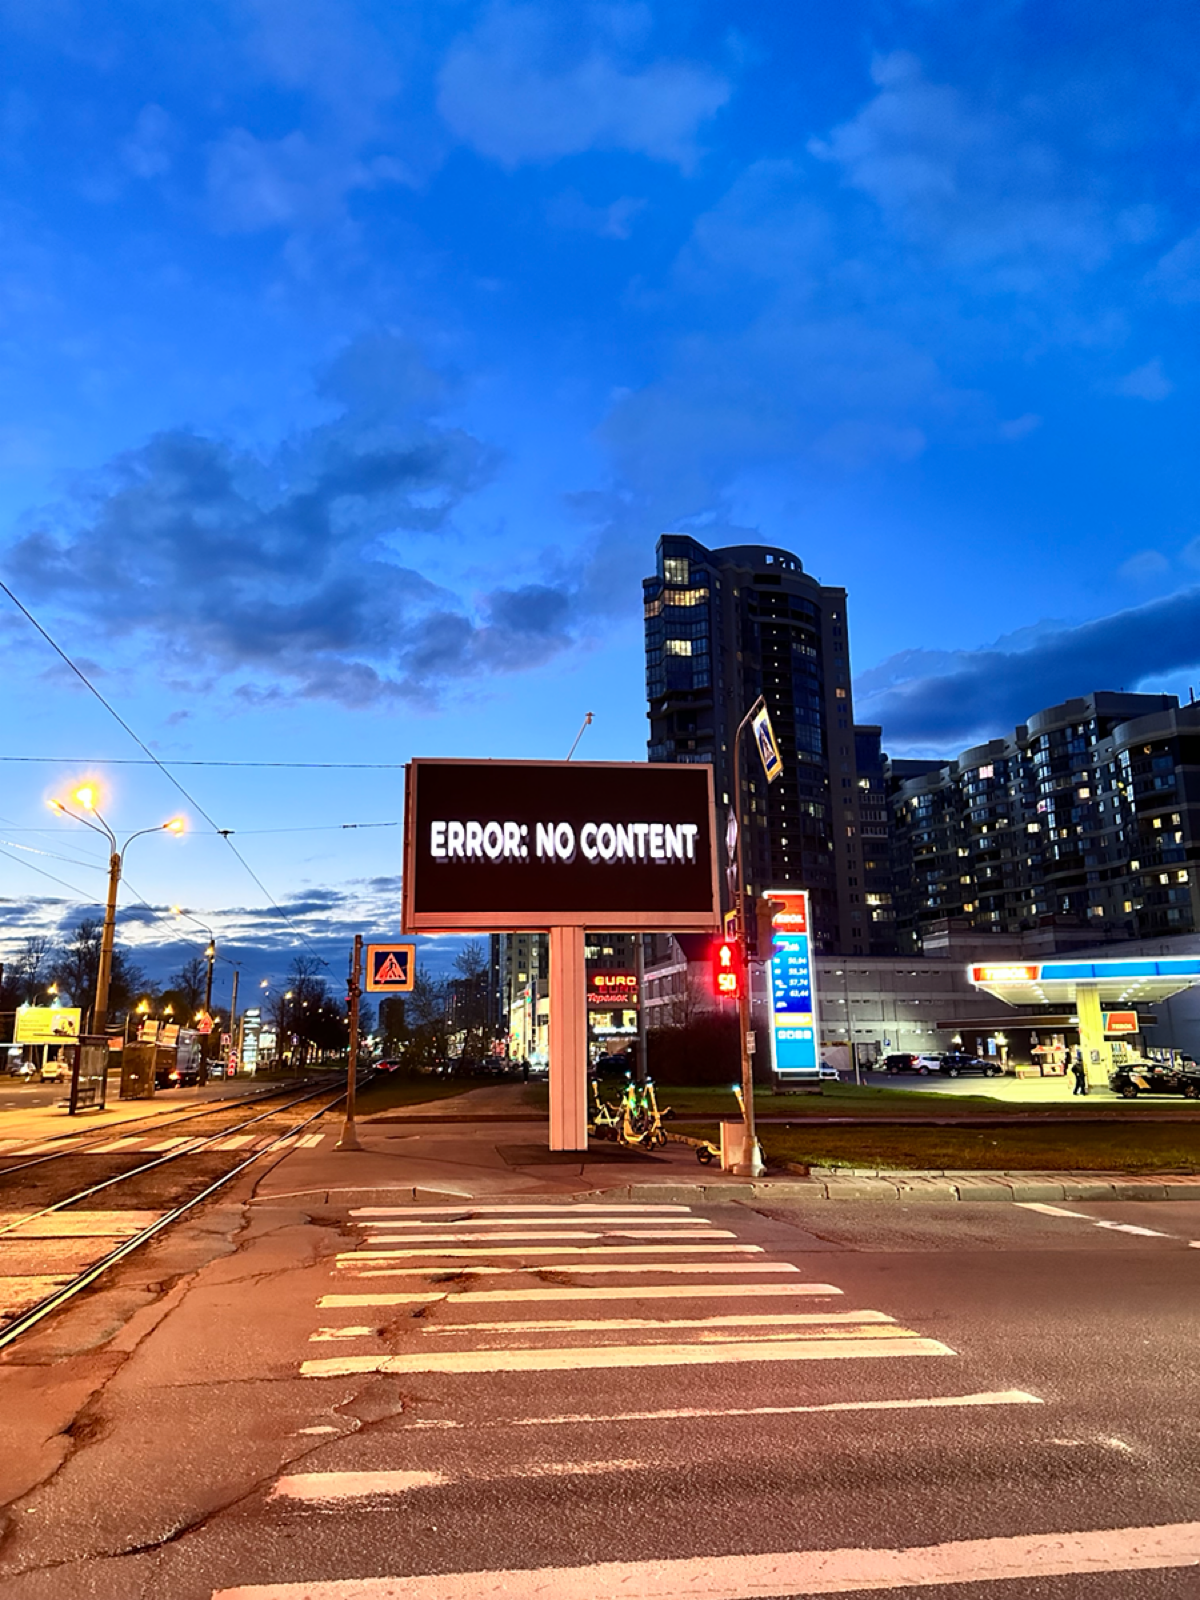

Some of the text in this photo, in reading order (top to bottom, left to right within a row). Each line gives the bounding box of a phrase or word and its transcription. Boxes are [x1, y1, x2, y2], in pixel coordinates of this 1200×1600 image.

[430, 820, 698, 859] ERROR: NO CONTENT
[718, 973, 736, 990] 50
